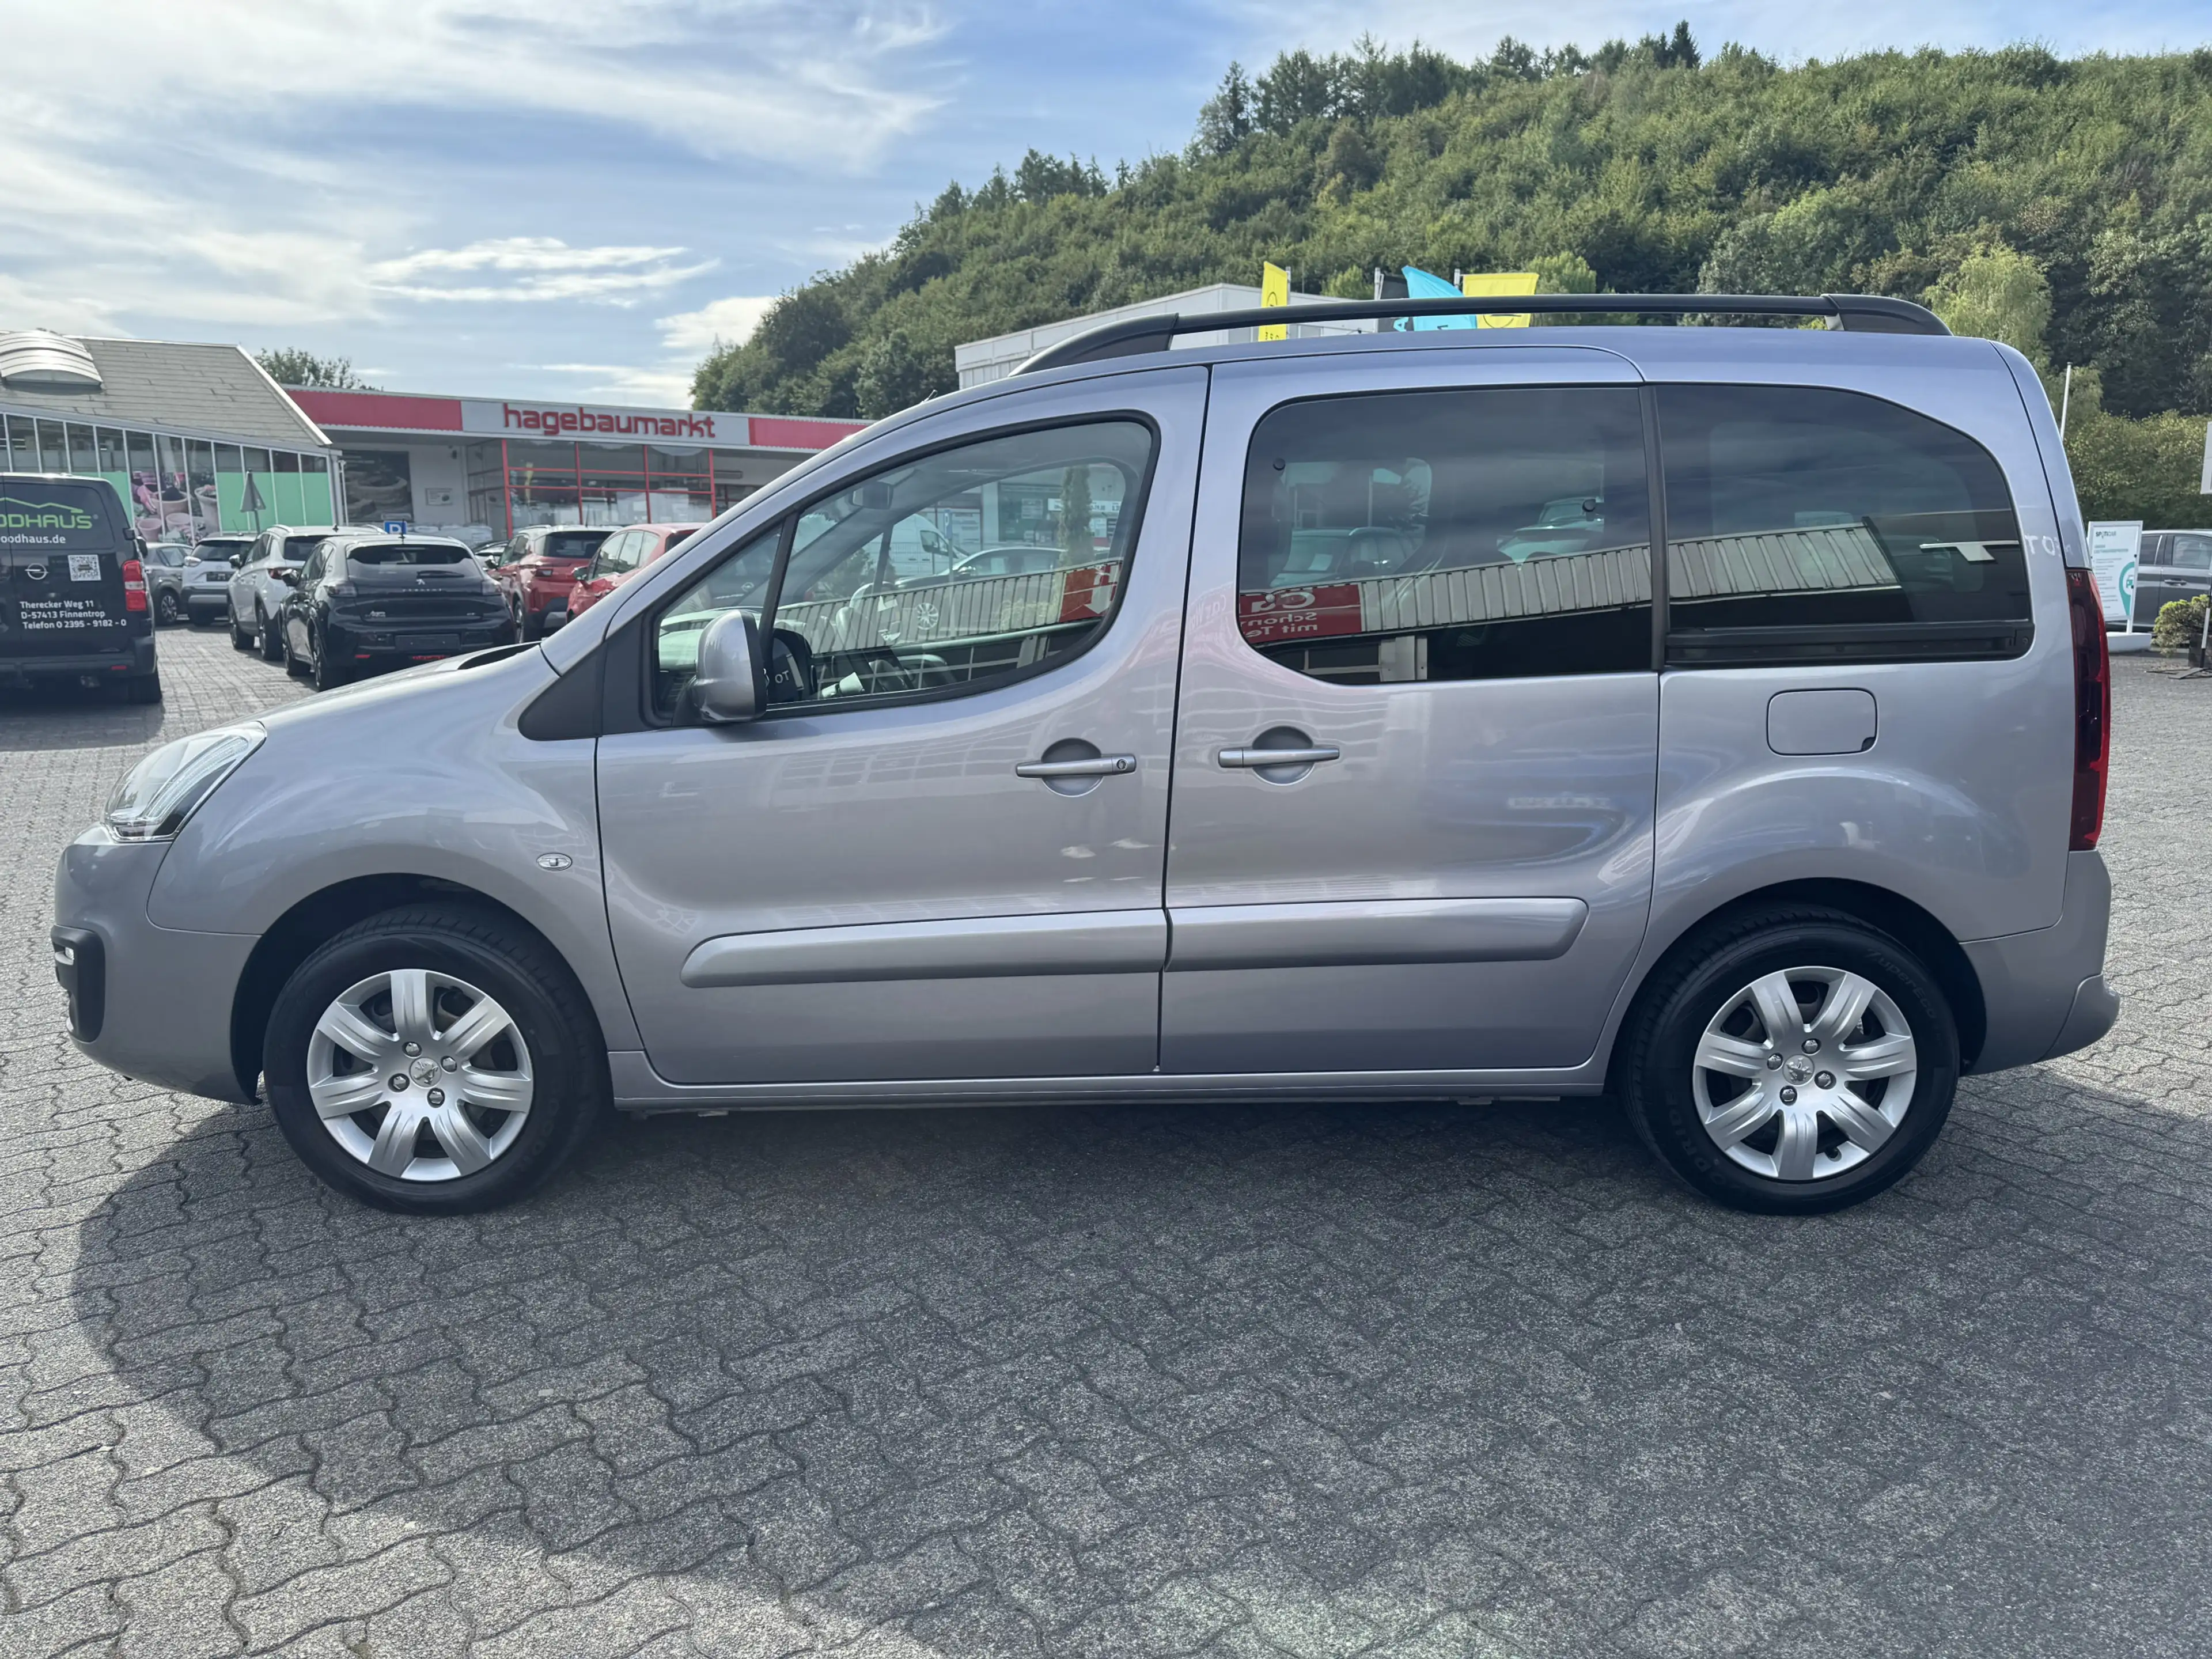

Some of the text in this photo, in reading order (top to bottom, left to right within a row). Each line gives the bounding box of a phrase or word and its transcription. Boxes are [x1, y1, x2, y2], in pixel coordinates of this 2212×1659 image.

[503, 403, 715, 438] hagebaumarkt
[20, 601, 61, 609] Therecker
[64, 600, 83, 609] Weg
[21, 611, 105, 619] D-57413 Finnentrop
